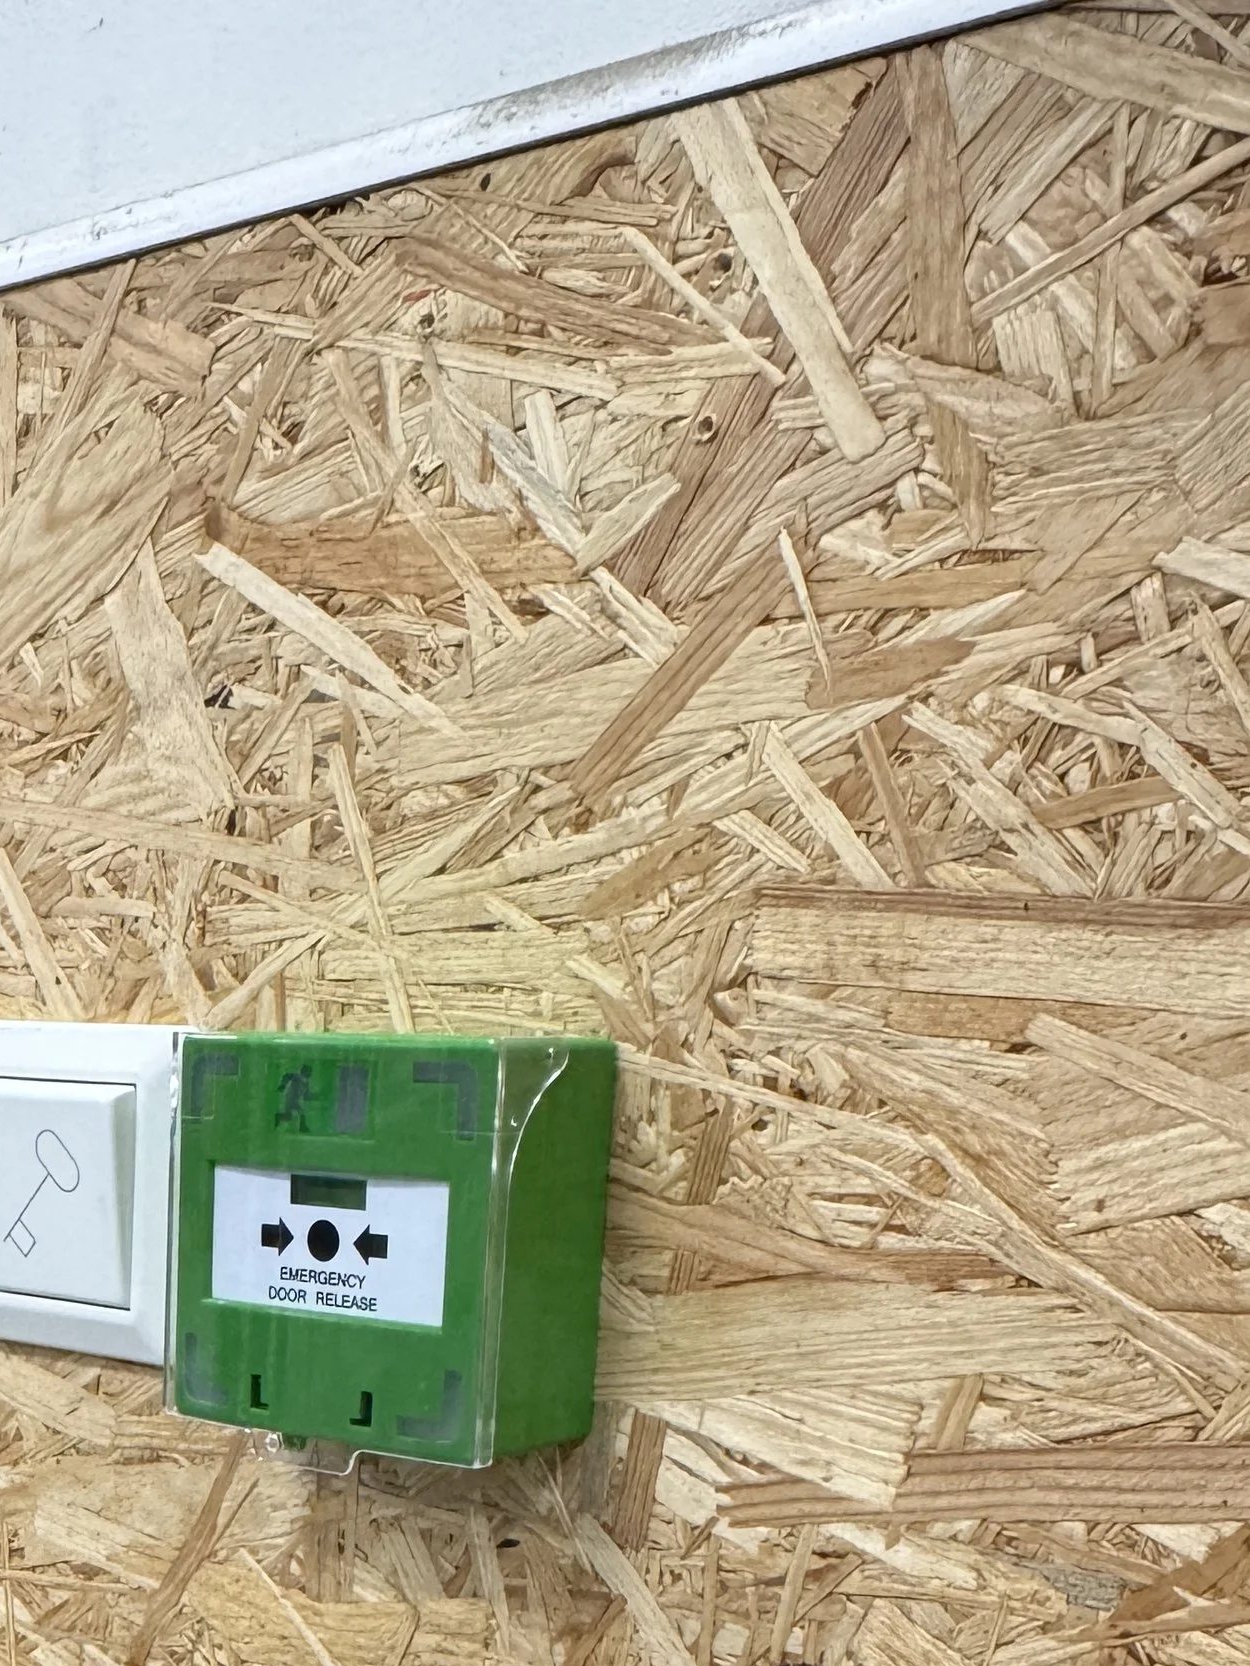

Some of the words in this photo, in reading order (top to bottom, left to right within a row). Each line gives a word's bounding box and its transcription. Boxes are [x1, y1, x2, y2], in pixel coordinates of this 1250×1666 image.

[280, 1266, 366, 1289] EMERGENCY
[268, 1285, 307, 1304] DOOR
[316, 1291, 378, 1312] RELEASE
